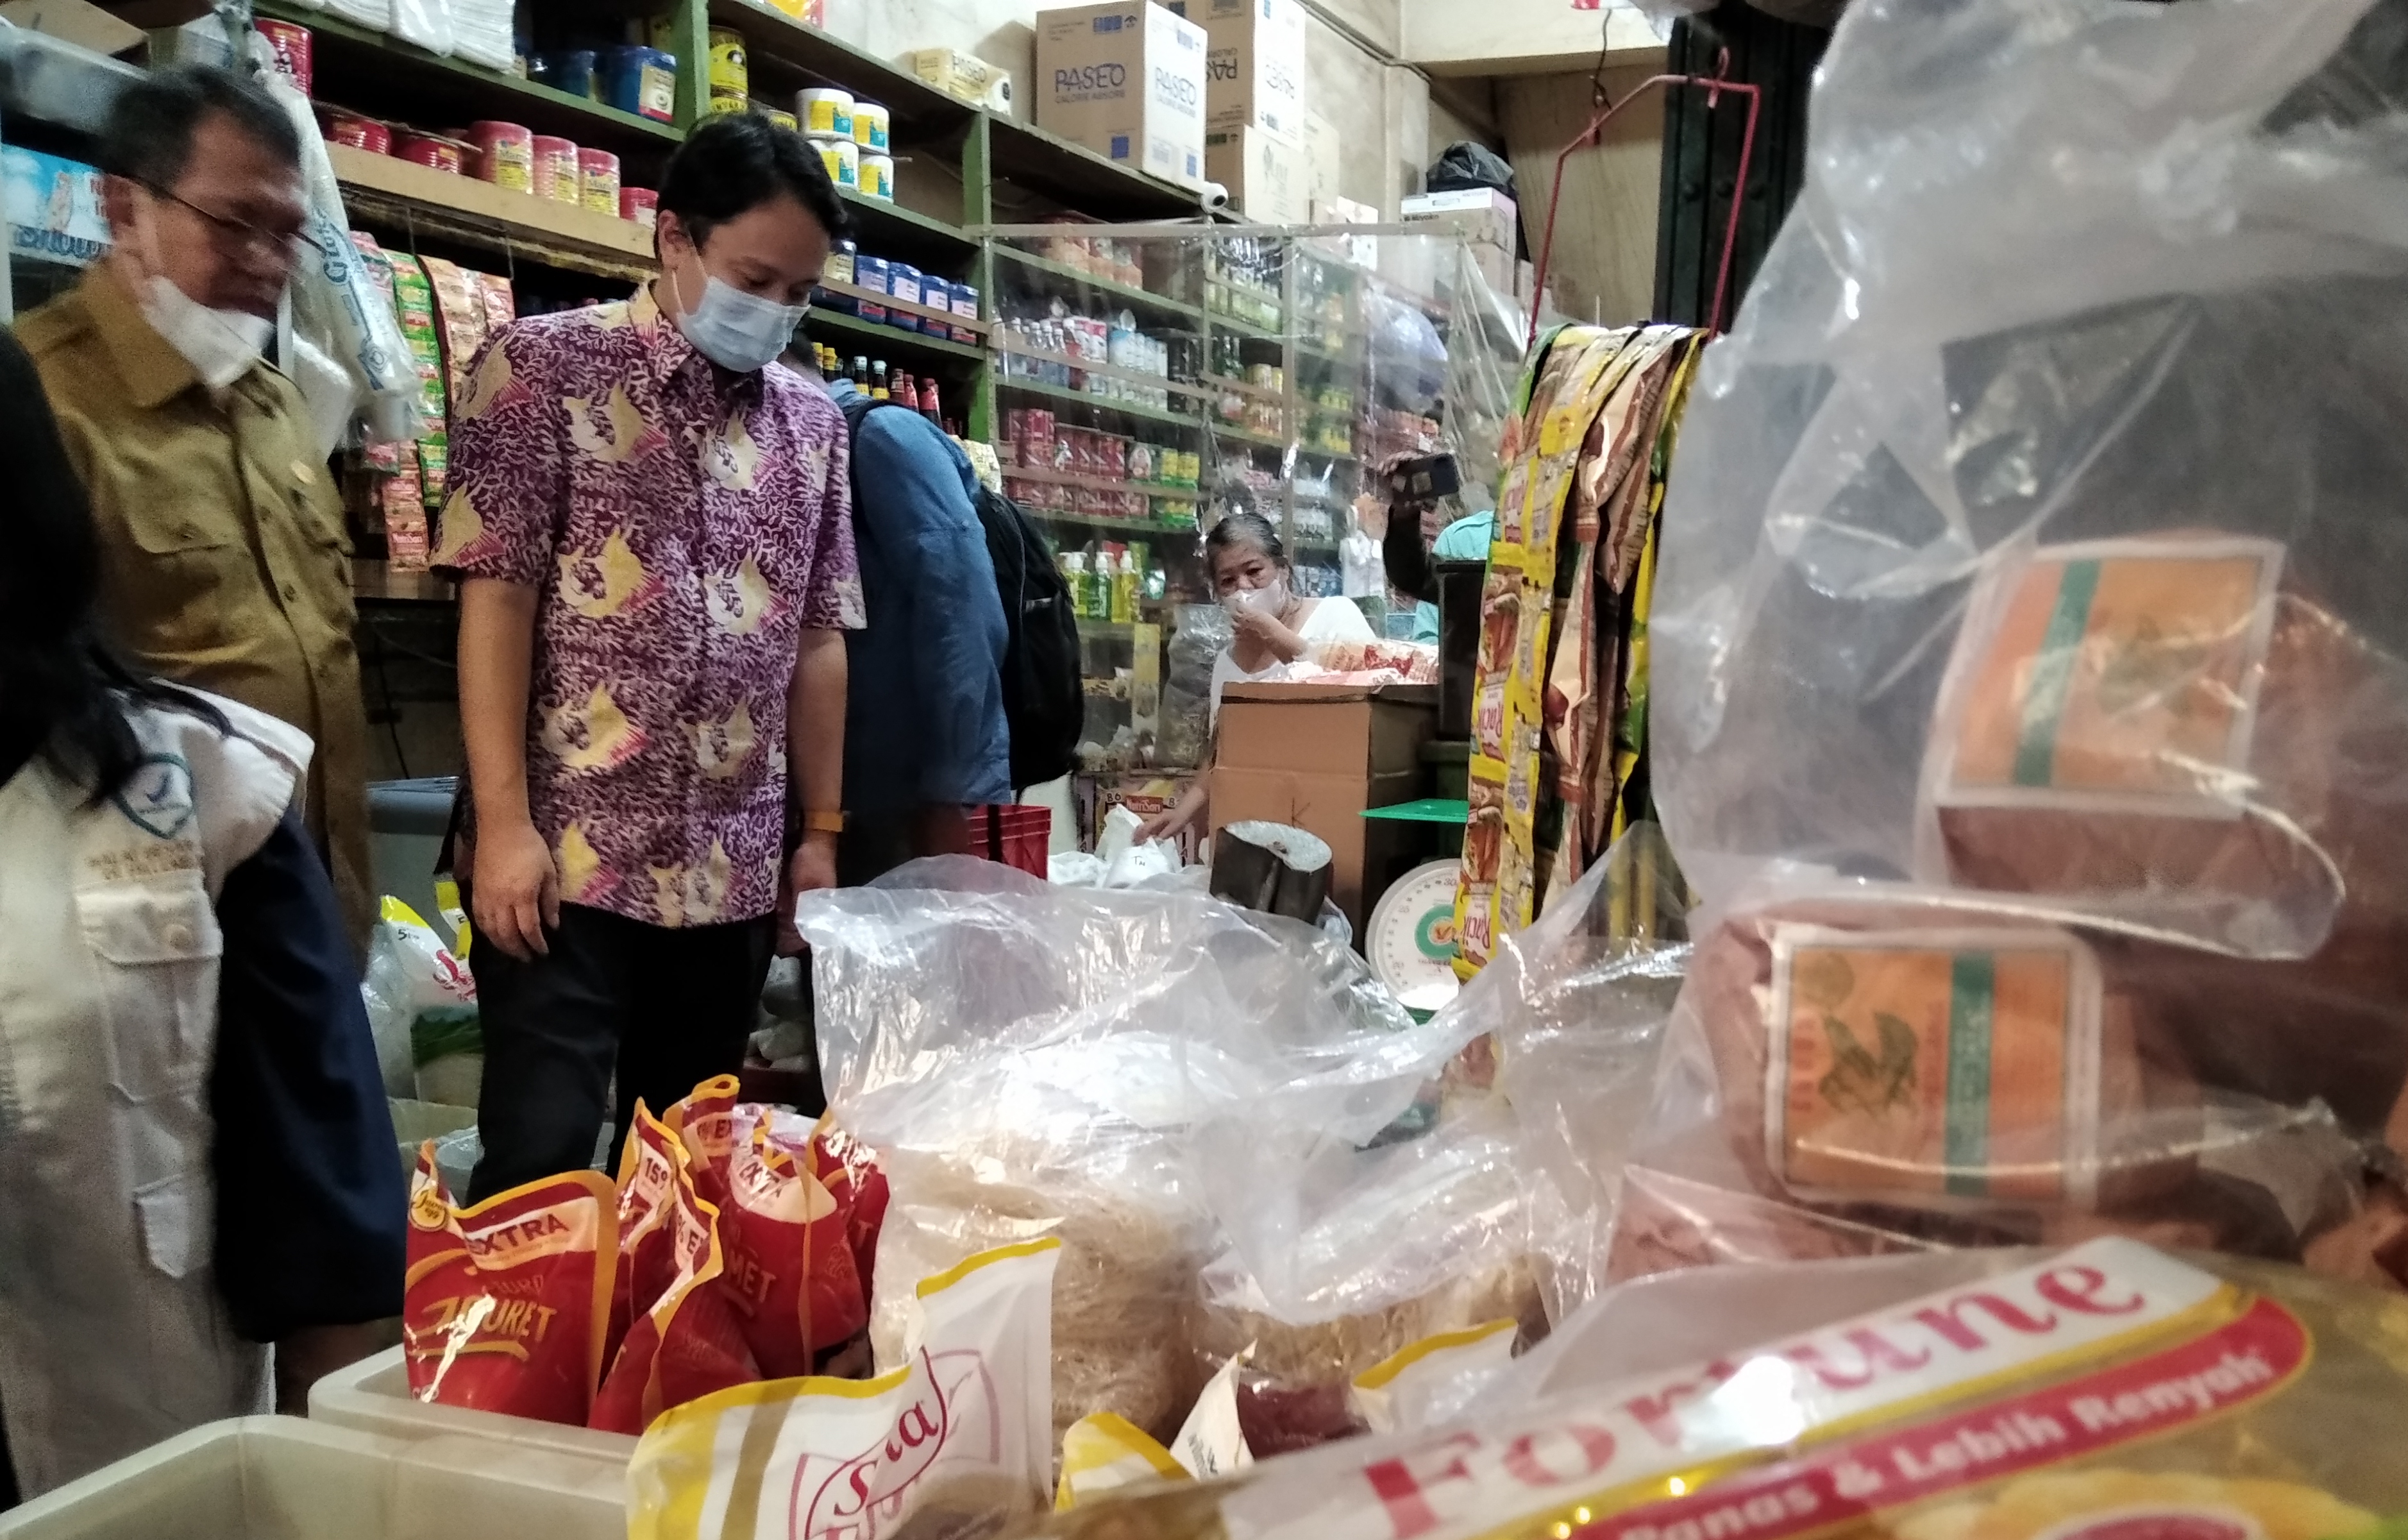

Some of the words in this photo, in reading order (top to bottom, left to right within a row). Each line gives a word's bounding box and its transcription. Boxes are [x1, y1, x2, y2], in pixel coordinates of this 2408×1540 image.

[1055, 63, 1126, 92] PASEO
[1156, 67, 1197, 105] PASEO
[1107, 793, 1122, 802] B6
[1126, 797, 1161, 812] NutriSari
[466, 1214, 571, 1255] EXTRA
[1363, 1264, 2144, 1539] Forune
[1830, 1459, 1883, 1499] &
[1892, 1408, 2067, 1483] Lebih
[2069, 1351, 2275, 1433] Renyah
